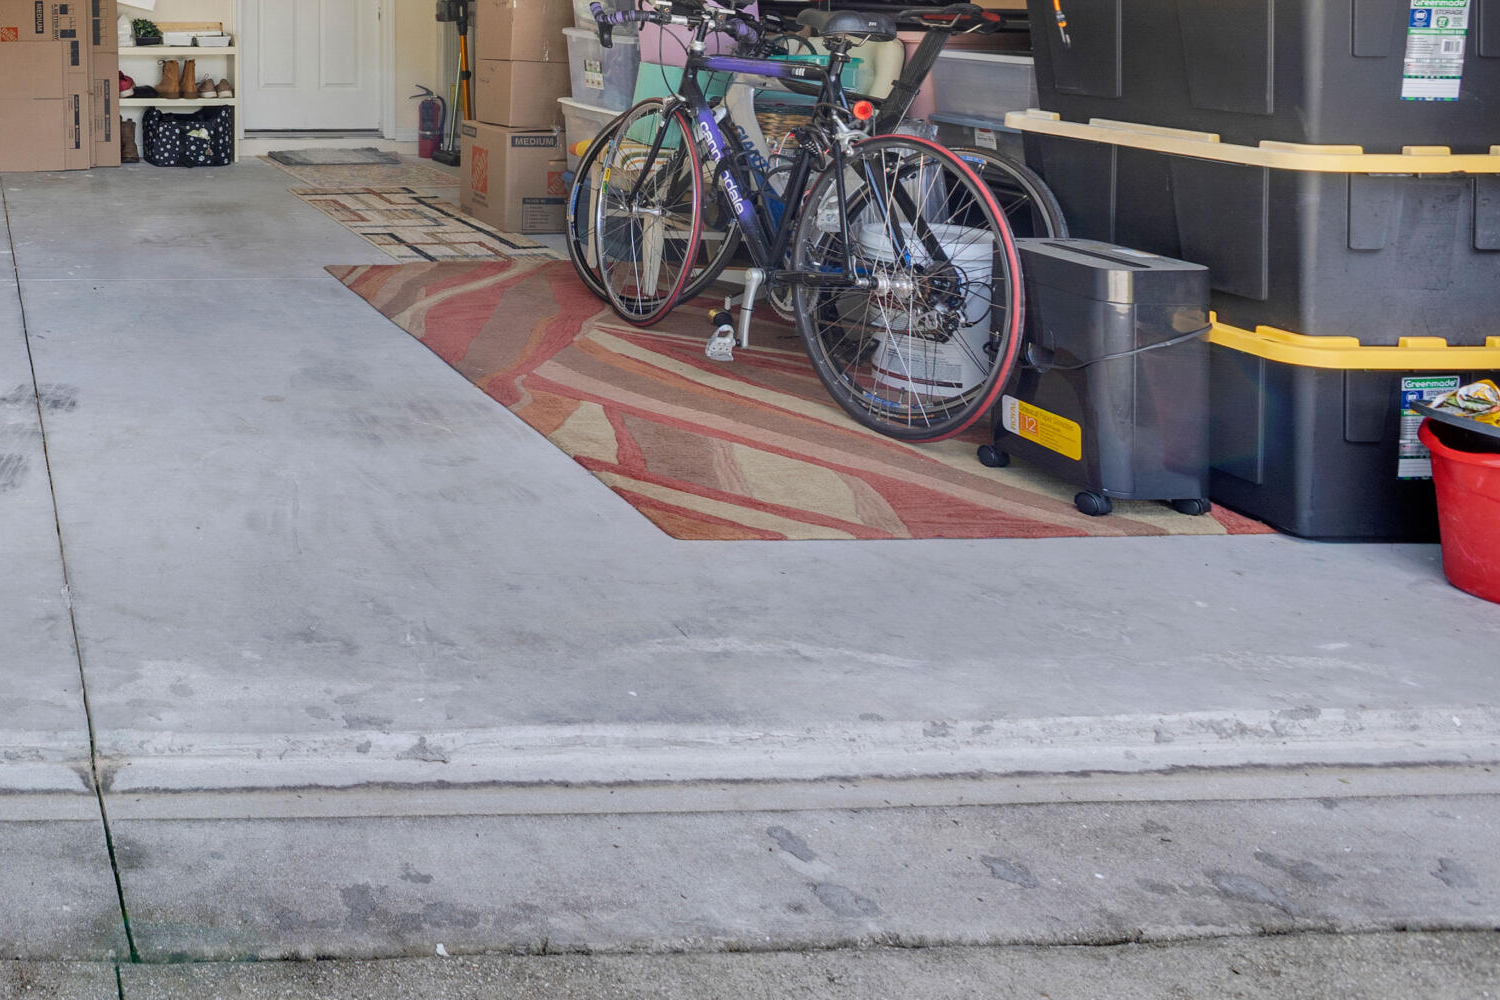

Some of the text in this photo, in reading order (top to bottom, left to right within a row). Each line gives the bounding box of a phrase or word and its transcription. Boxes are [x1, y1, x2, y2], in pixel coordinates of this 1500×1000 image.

[515, 137, 554, 146] MEDIUM
[700, 121, 744, 215] cannndale
[1405, 380, 1457, 389] Greenmade
[1025, 415, 1037, 433] 12
